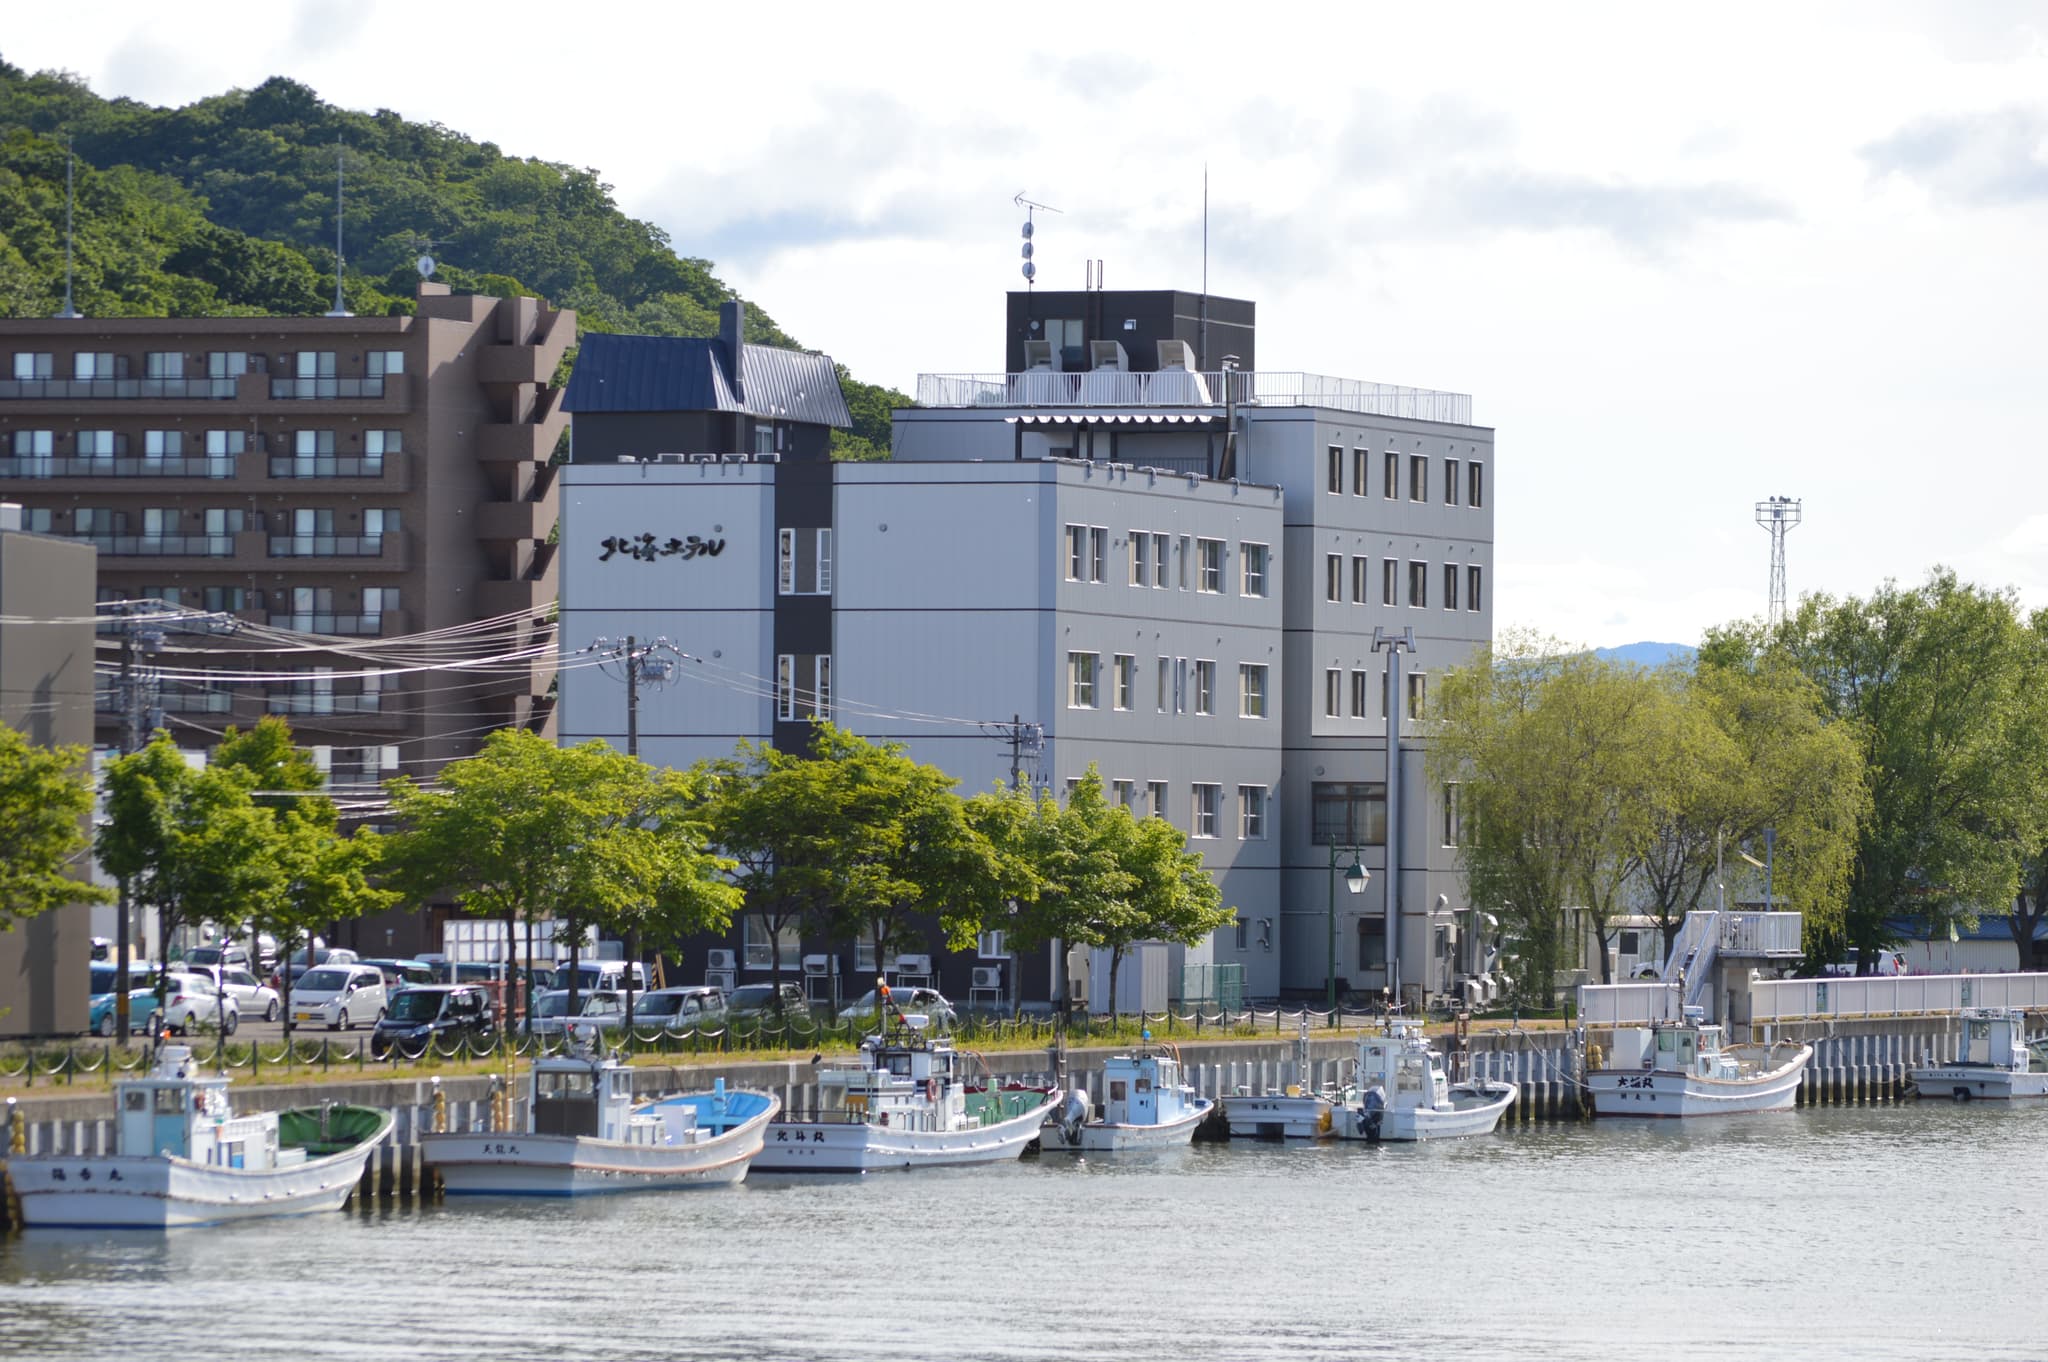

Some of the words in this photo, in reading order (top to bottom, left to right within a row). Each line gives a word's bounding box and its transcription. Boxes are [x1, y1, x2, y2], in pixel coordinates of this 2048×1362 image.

[598, 532, 726, 562] 北海ホテル
